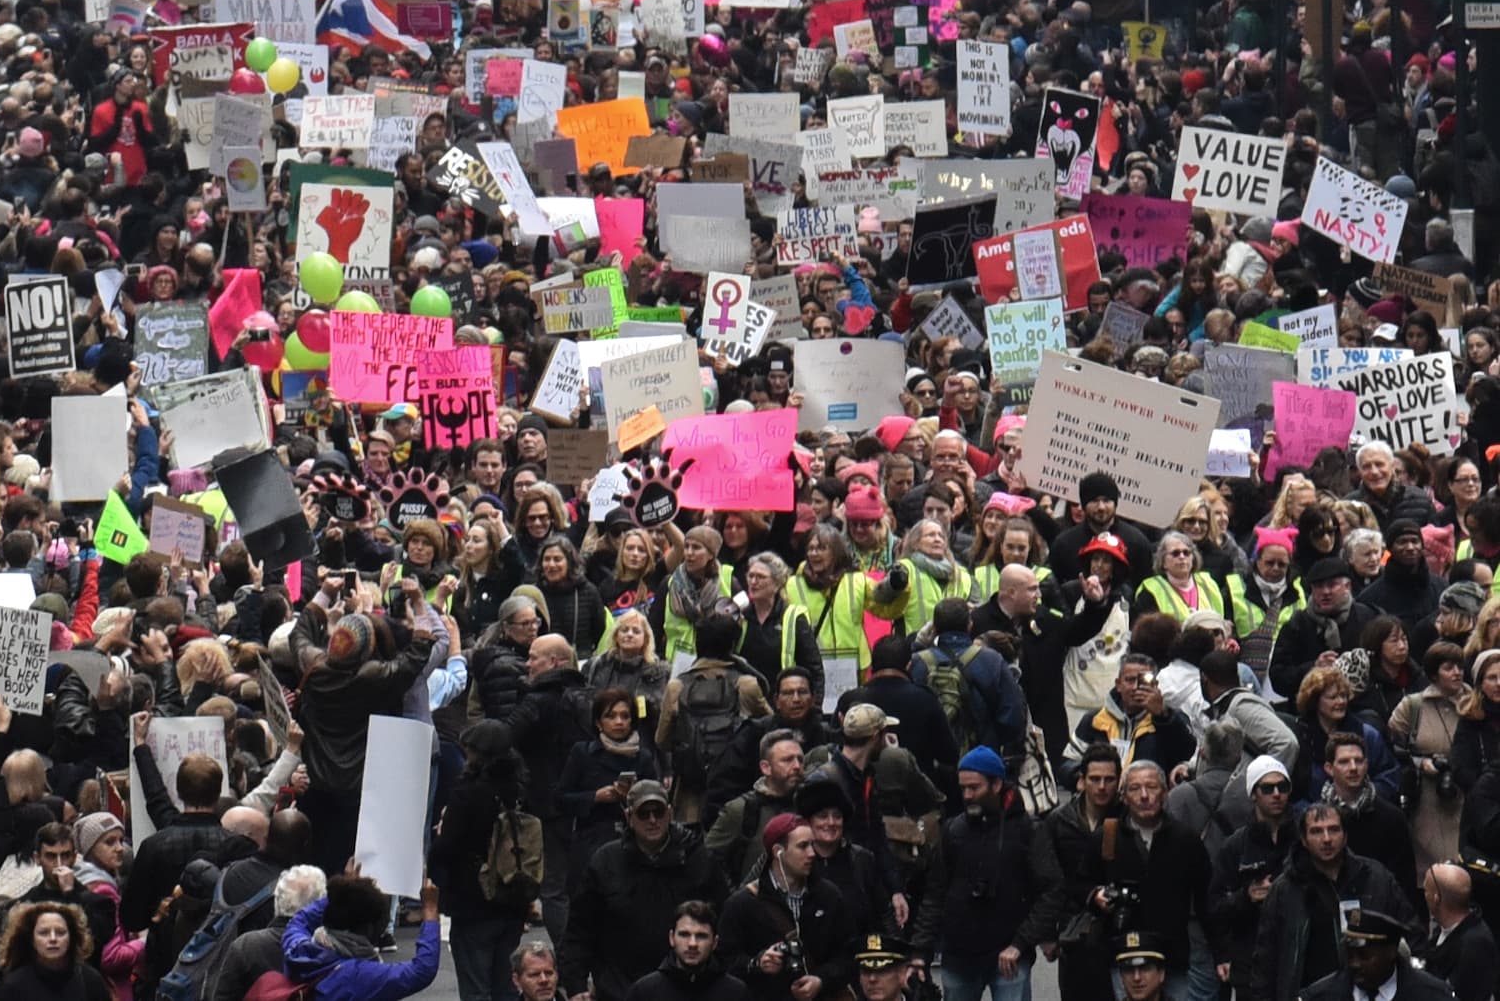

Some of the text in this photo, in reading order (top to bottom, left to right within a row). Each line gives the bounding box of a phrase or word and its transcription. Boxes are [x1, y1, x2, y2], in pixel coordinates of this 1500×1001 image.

[175, 34, 235, 49] BATALA
[964, 41, 994, 56] THIS IS
[969, 58, 998, 72] NOT A
[973, 96, 992, 107] THE
[1195, 133, 1284, 172] VALUE
[939, 172, 972, 191] Why
[1200, 169, 1270, 205] LOVE
[777, 236, 842, 262] RESPECT
[8, 284, 65, 333] NO!
[989, 307, 1047, 326] We will
[1283, 314, 1319, 331] not my
[991, 328, 1048, 347] not go
[1302, 325, 1333, 341] sident
[1312, 349, 1403, 365] IF YOU ARE
[435, 377, 491, 389] BUILT ON
[1337, 357, 1446, 397] WARRIORS
[1112, 397, 1155, 419] POWER
[1359, 395, 1388, 421] OF
[1396, 384, 1445, 413] LOVE
[1056, 409, 1131, 443] PRO CHOICE
[1049, 436, 1120, 468] EQUAL PAY
[1052, 423, 1130, 456] AFFORDABLE
[1134, 447, 1184, 474] HEALTH
[1046, 450, 1089, 473] VOTING
[1, 606, 39, 625] WOMAN
[10, 624, 40, 640] CALL
[21, 642, 46, 657] FREE
[25, 657, 46, 670] NOT
[18, 670, 40, 684] HER
[3, 679, 35, 696] BODY
